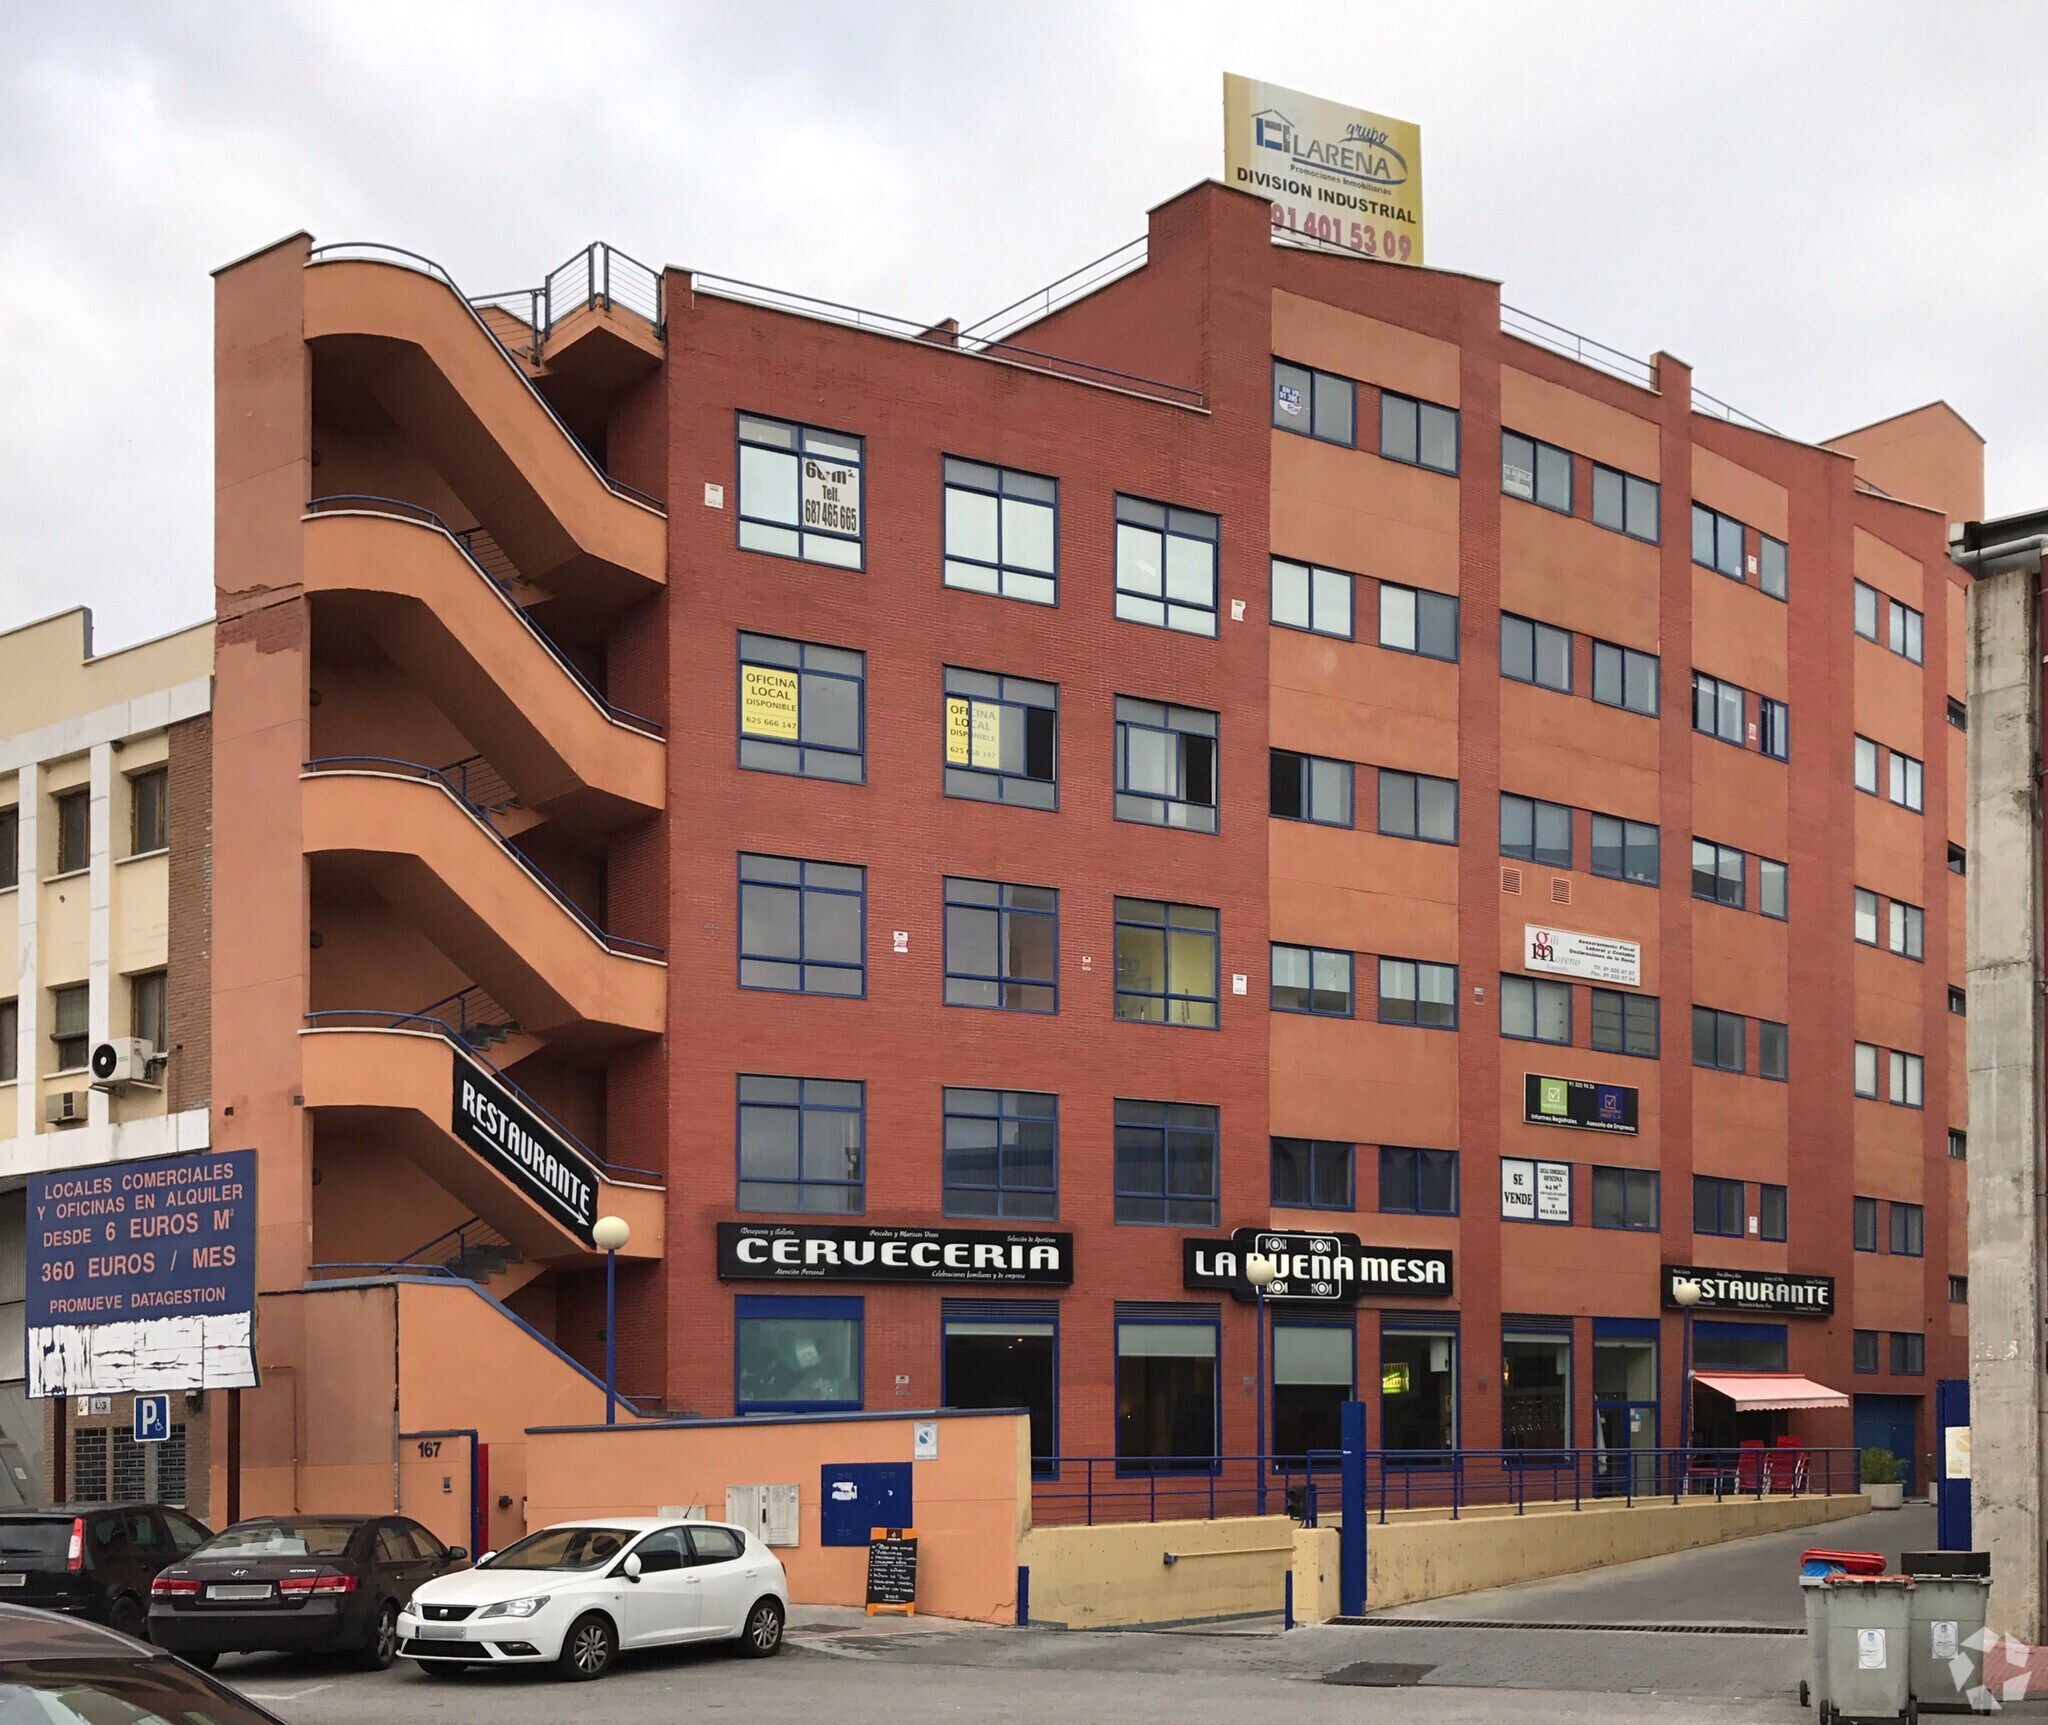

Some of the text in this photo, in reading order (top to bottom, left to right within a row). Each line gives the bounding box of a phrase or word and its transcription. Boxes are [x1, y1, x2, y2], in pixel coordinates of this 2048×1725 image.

[1346, 121, 1389, 149] grupo
[1290, 163, 1392, 196] Promociones Inmobiliarias
[1237, 167, 1416, 224] DIVISION INDUSTRIAL
[1271, 203, 1412, 262] 91 401 53 09
[821, 484, 841, 503] Telf.
[805, 498, 857, 532] 687 465 665
[746, 672, 797, 690] OFICINA
[751, 685, 792, 701] LOCAL
[746, 697, 797, 712] DISPONIBLE
[746, 716, 797, 729] 625 666 147
[950, 745, 964, 754] 625
[982, 751, 996, 759] 147
[1530, 1113, 1552, 1121] Informes
[462, 1079, 591, 1216] RESTAURANTE
[44, 1163, 234, 1200] LOCALES COMERCIALES
[1512, 1173, 1524, 1186] SE
[37, 1184, 243, 1221] Y OFICINAS EN ALQUILER
[1504, 1191, 1533, 1206] VENDE
[43, 1228, 91, 1247] DESDE
[105, 1221, 116, 1241] 6
[130, 1213, 199, 1239] EUROS
[41, 1261, 75, 1282] 360
[88, 1252, 155, 1278] EUROS
[192, 1245, 237, 1269] MES
[736, 1237, 1060, 1270] CERVECERIA
[1195, 1250, 1237, 1277] LA
[1361, 1256, 1446, 1284] MESA
[50, 1286, 226, 1314] PROMUEVE DATAGESTION
[142, 1399, 157, 1435] P
[417, 1441, 442, 1458] 167
